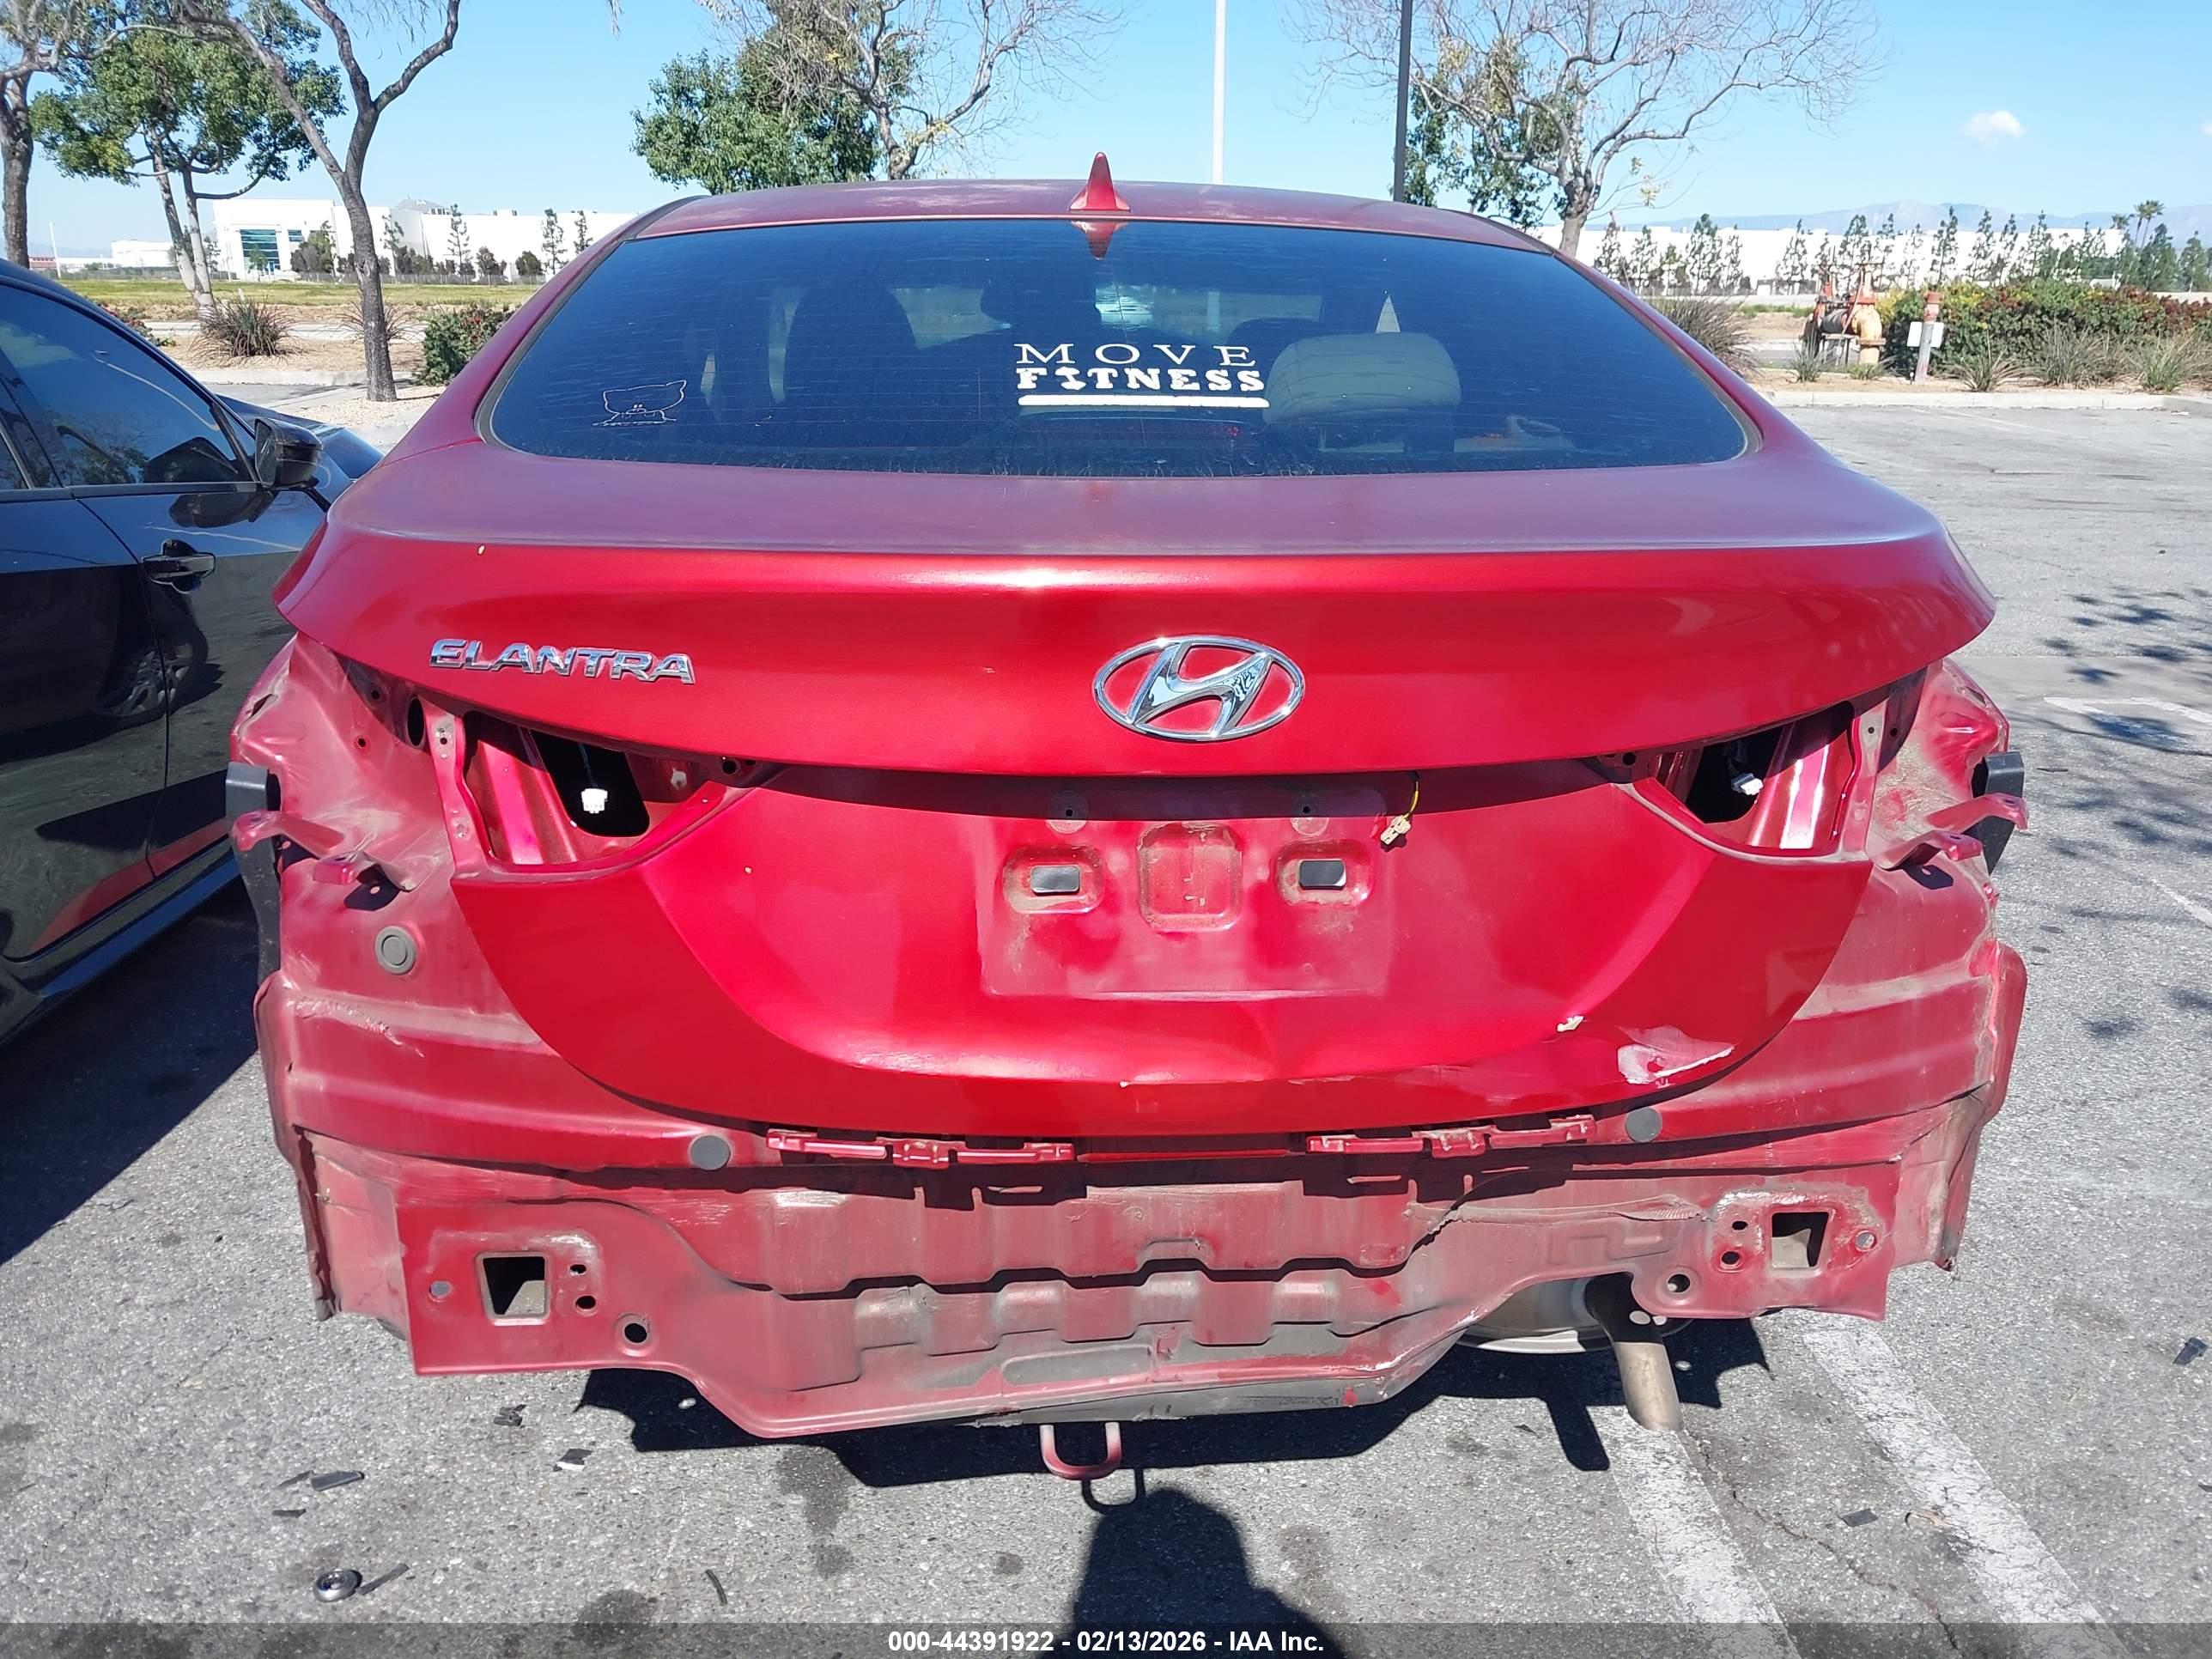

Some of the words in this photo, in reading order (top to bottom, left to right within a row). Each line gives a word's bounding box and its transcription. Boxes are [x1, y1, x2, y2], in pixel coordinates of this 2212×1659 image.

[1014, 343, 1256, 367] MOVE
[1016, 366, 1266, 392] FITNESS
[430, 638, 696, 684] ELANTRA
